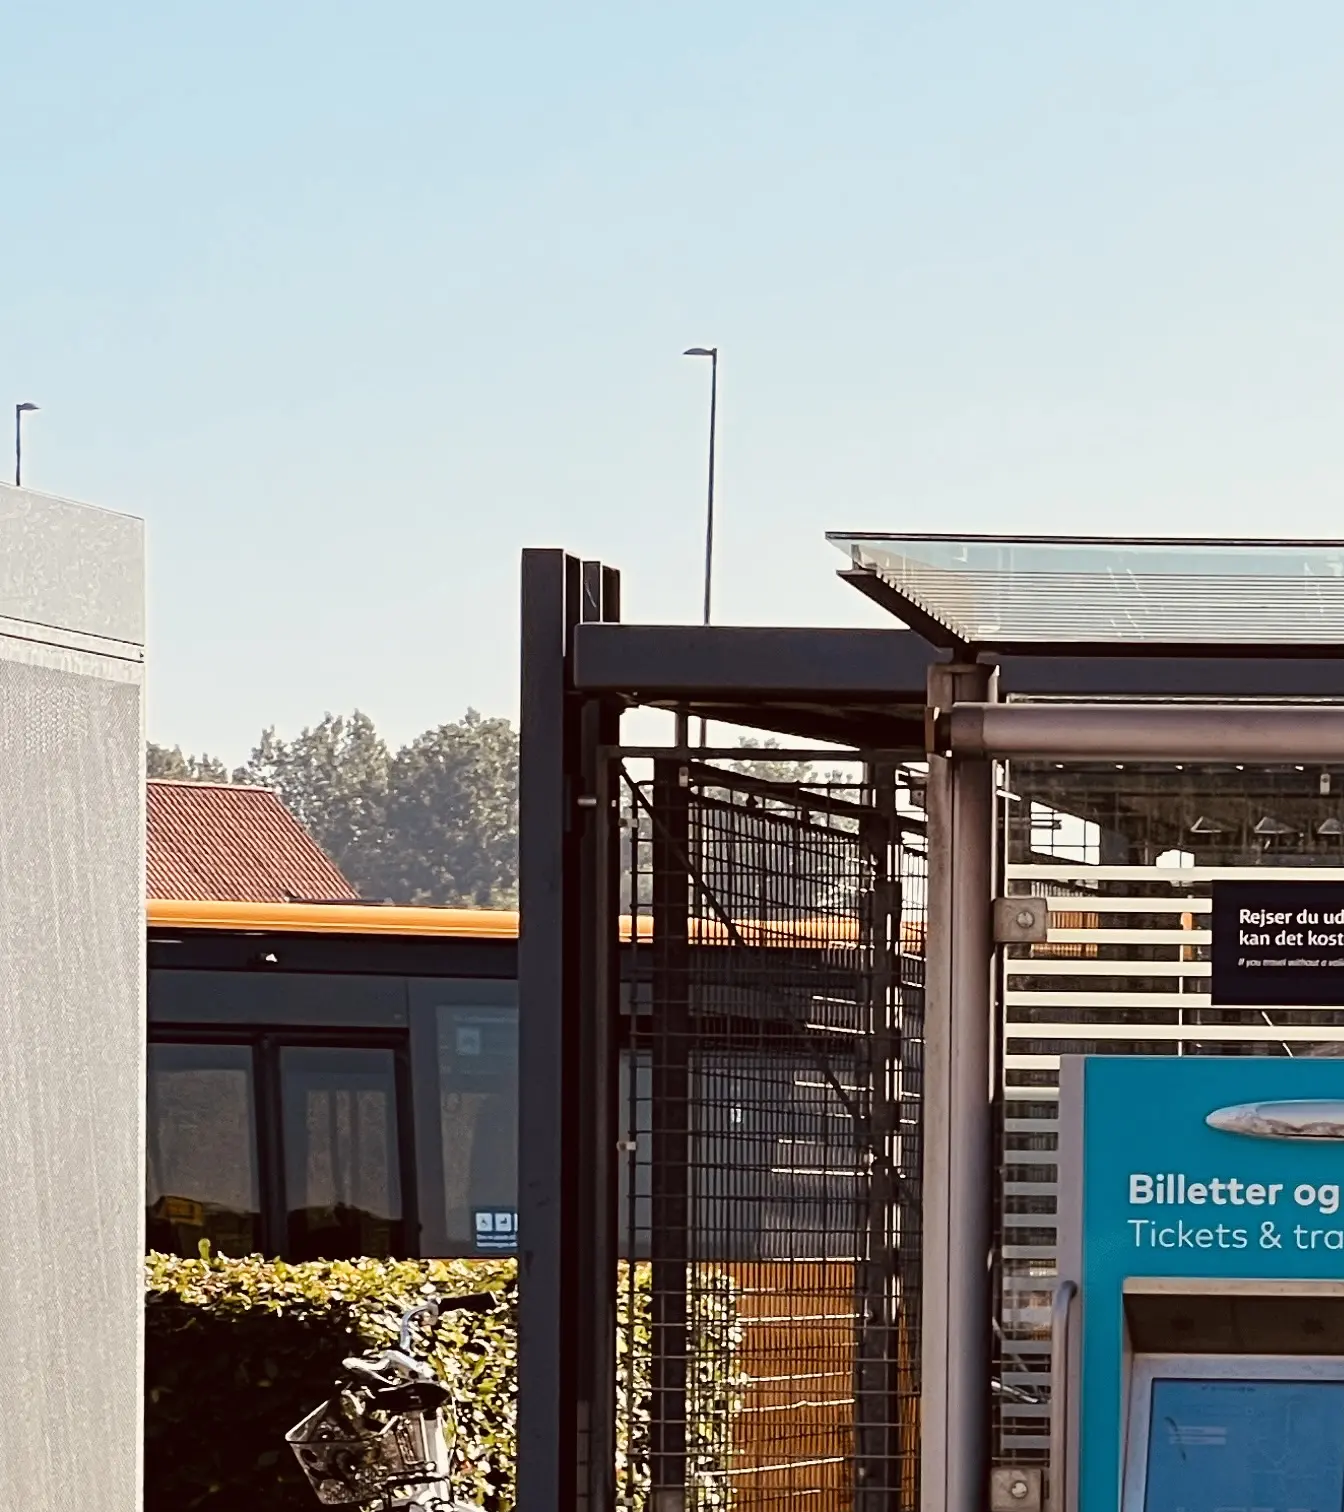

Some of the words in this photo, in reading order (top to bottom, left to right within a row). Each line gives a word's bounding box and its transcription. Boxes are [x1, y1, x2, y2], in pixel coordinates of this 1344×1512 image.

[1239, 909, 1293, 927] Rejser
[1296, 909, 1319, 925] du
[1239, 930, 1270, 946] kan
[1274, 930, 1304, 946] det
[1129, 1173, 1283, 1205] Billetter
[1294, 1183, 1340, 1214] og
[1127, 1219, 1248, 1248] Tickets
[1259, 1221, 1282, 1249] &
